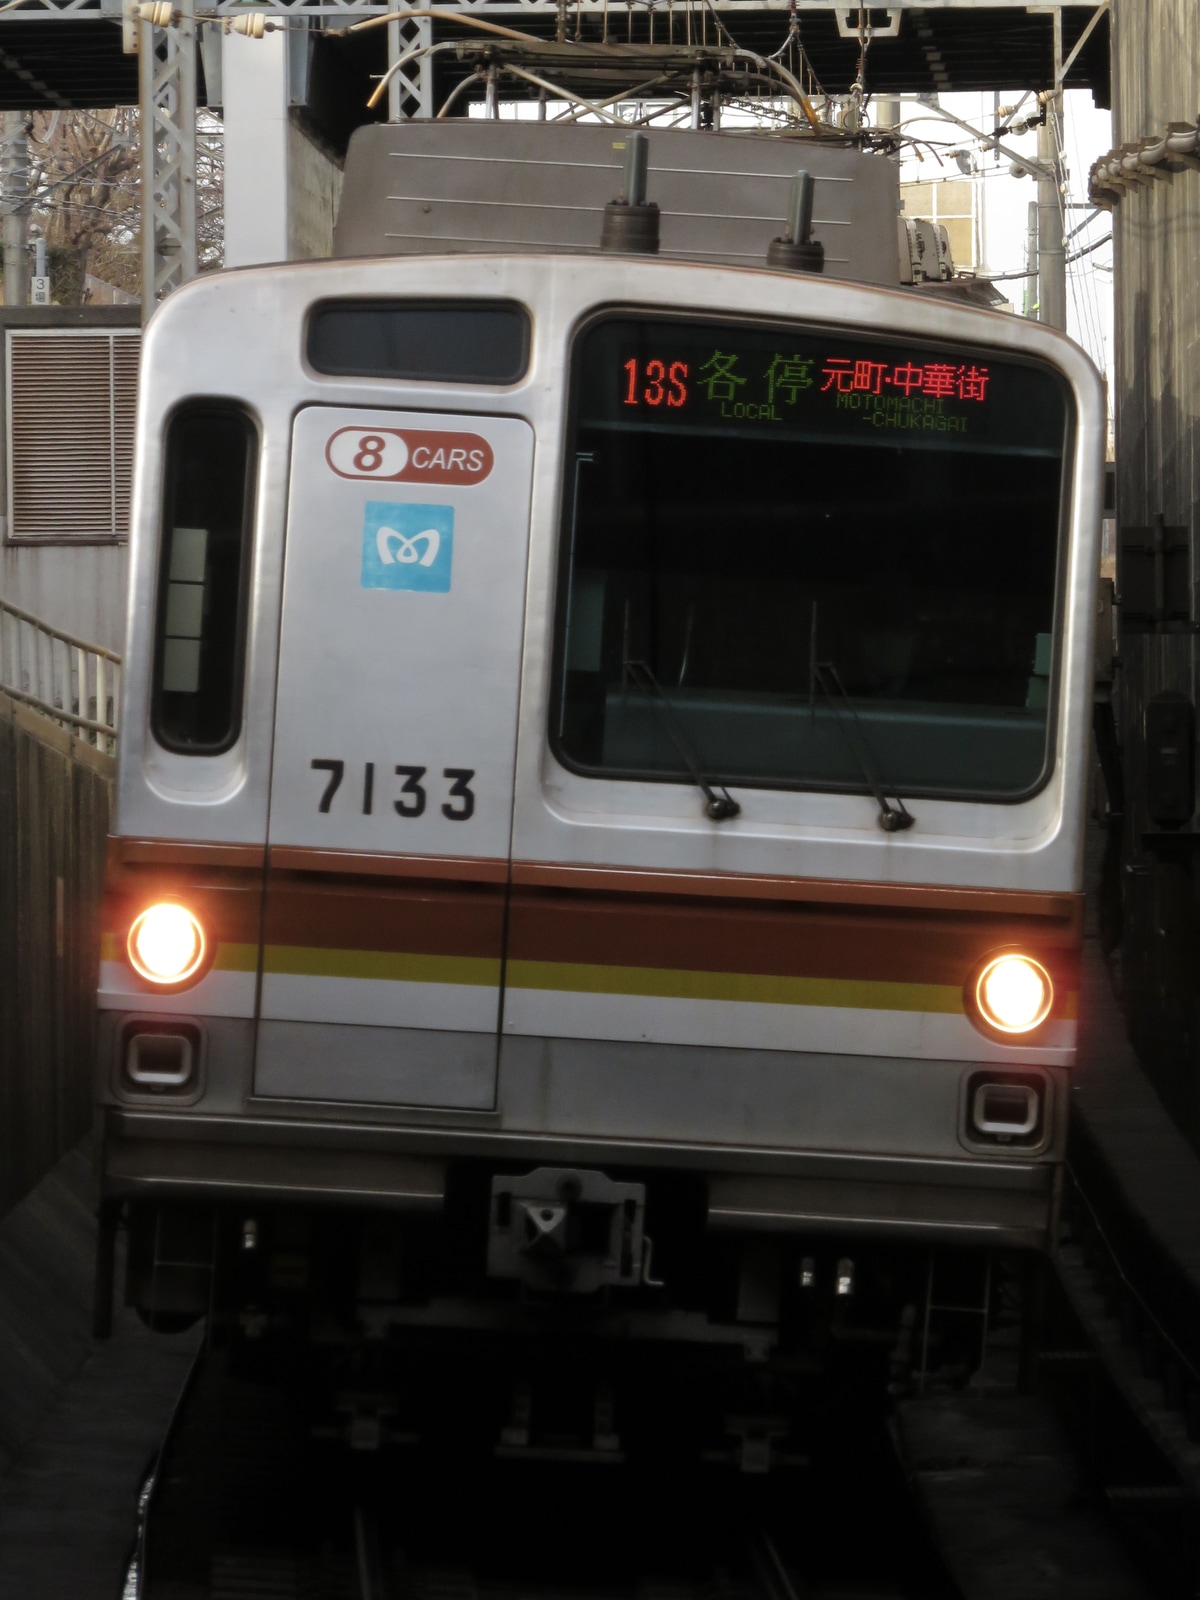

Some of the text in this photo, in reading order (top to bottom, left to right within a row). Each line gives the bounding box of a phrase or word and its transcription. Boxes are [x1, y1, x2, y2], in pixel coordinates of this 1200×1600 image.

[623, 357, 689, 407] 13S
[721, 401, 783, 421] LOCAL
[836, 393, 945, 414] MOTOMACHI
[862, 411, 968, 432] -CHUKAGAI
[352, 435, 485, 472] 8 CARS
[310, 758, 476, 821] 7133
